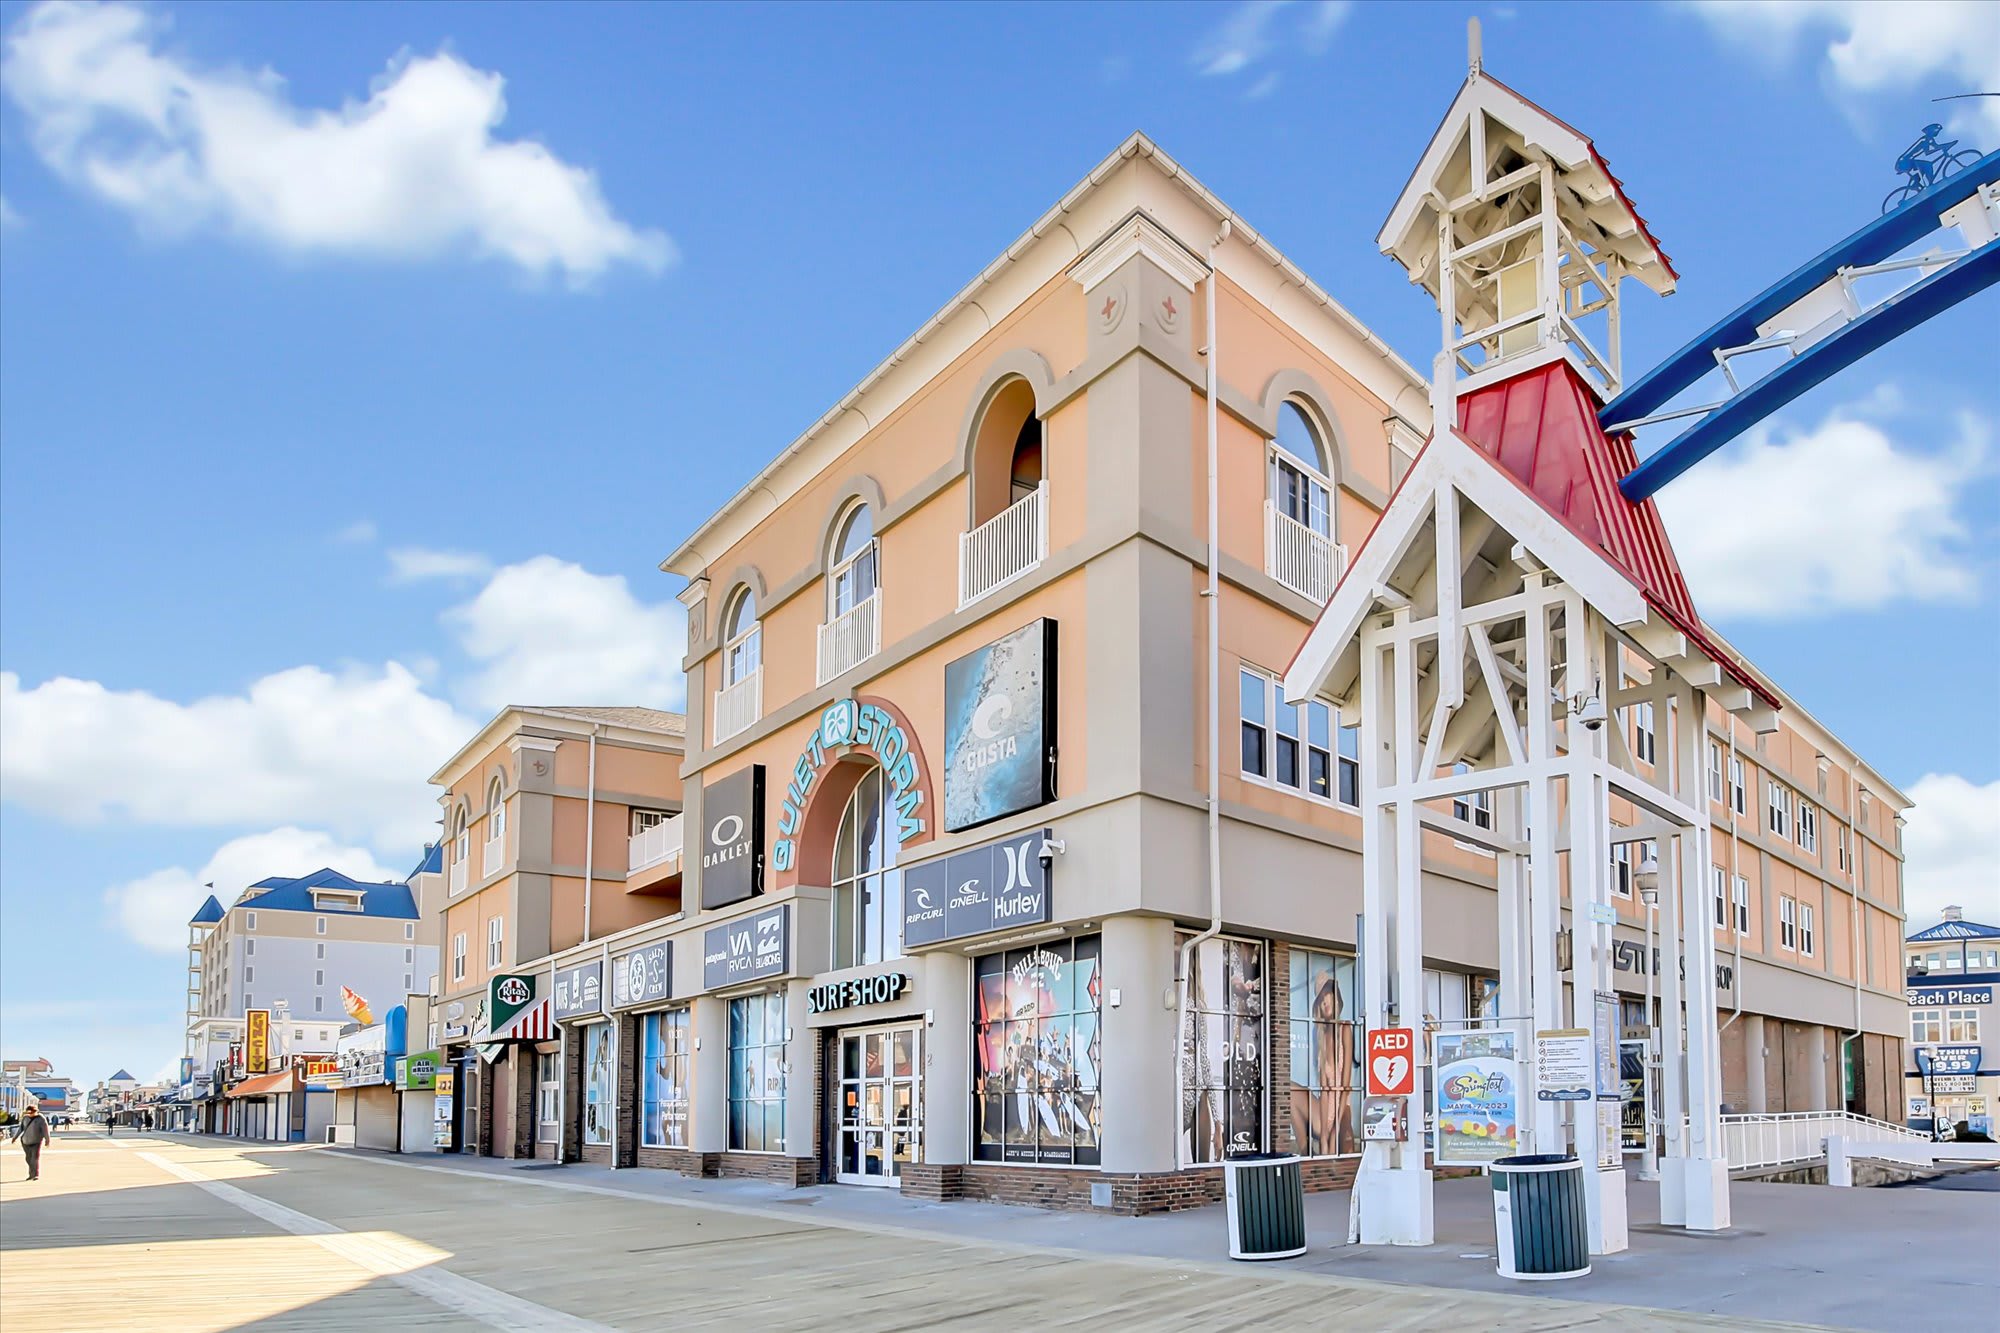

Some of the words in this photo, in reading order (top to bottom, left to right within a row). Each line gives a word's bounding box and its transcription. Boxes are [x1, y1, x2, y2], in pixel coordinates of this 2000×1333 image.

[966, 735, 1017, 772] COSTA
[771, 729, 823, 872] QUIET
[857, 704, 922, 843] STORM
[703, 840, 752, 869] OAKLEY
[949, 891, 989, 909] O'NEILL
[994, 892, 1042, 920] Hurley
[906, 912, 921, 924] RIP
[921, 908, 944, 921] CURL
[648, 948, 665, 964] SALTY
[729, 956, 753, 973] RVCA
[502, 986, 527, 997] Rita's
[648, 981, 663, 994] CREW
[807, 981, 848, 1014] SURF
[852, 973, 900, 1006] SHOP
[1947, 990, 1990, 1004] Place
[252, 1013, 263, 1039] FUN
[1372, 1033, 1409, 1050] AED
[252, 1040, 264, 1071] CITY
[309, 1063, 338, 1073] FUN
[1451, 1071, 1505, 1099] Springfest
